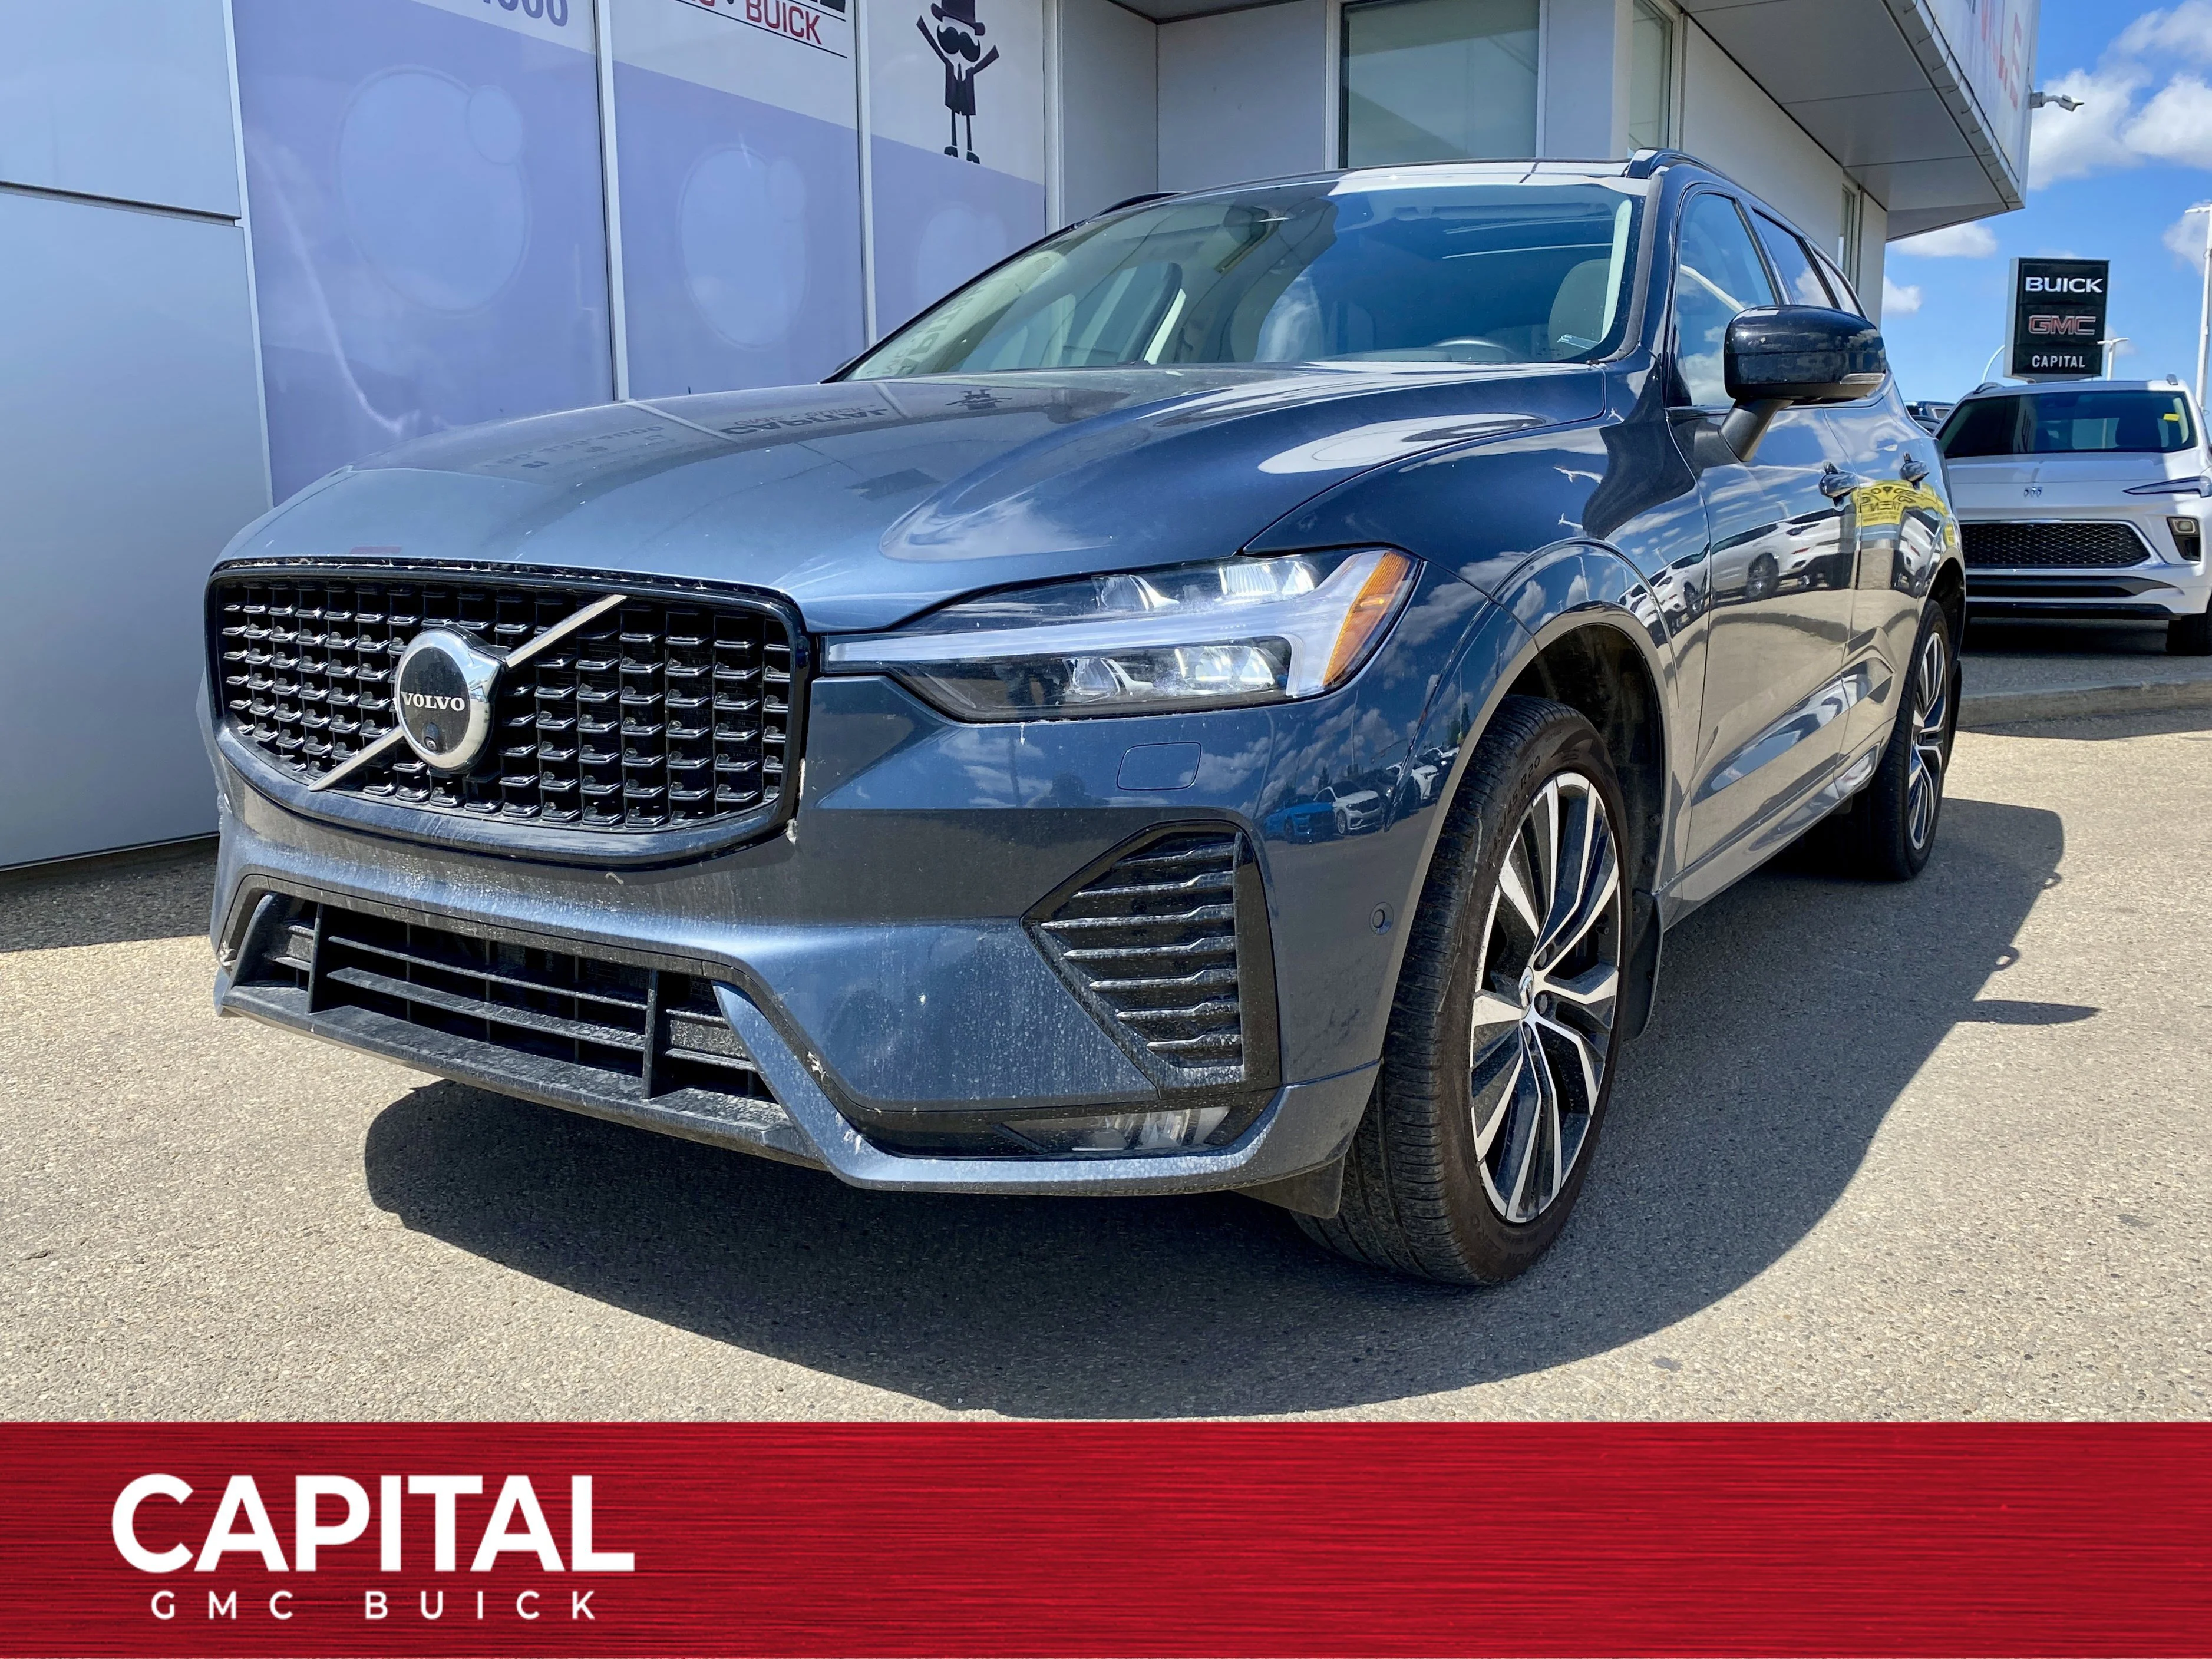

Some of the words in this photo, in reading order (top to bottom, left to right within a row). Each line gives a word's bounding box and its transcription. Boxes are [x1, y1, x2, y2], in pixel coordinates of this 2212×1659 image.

[745, 0, 822, 45] BUICK
[2025, 277, 2104, 293] BUICK
[2028, 315, 2097, 335] GMC
[2032, 355, 2086, 368] CAPITAL
[400, 692, 465, 712] VOLVO
